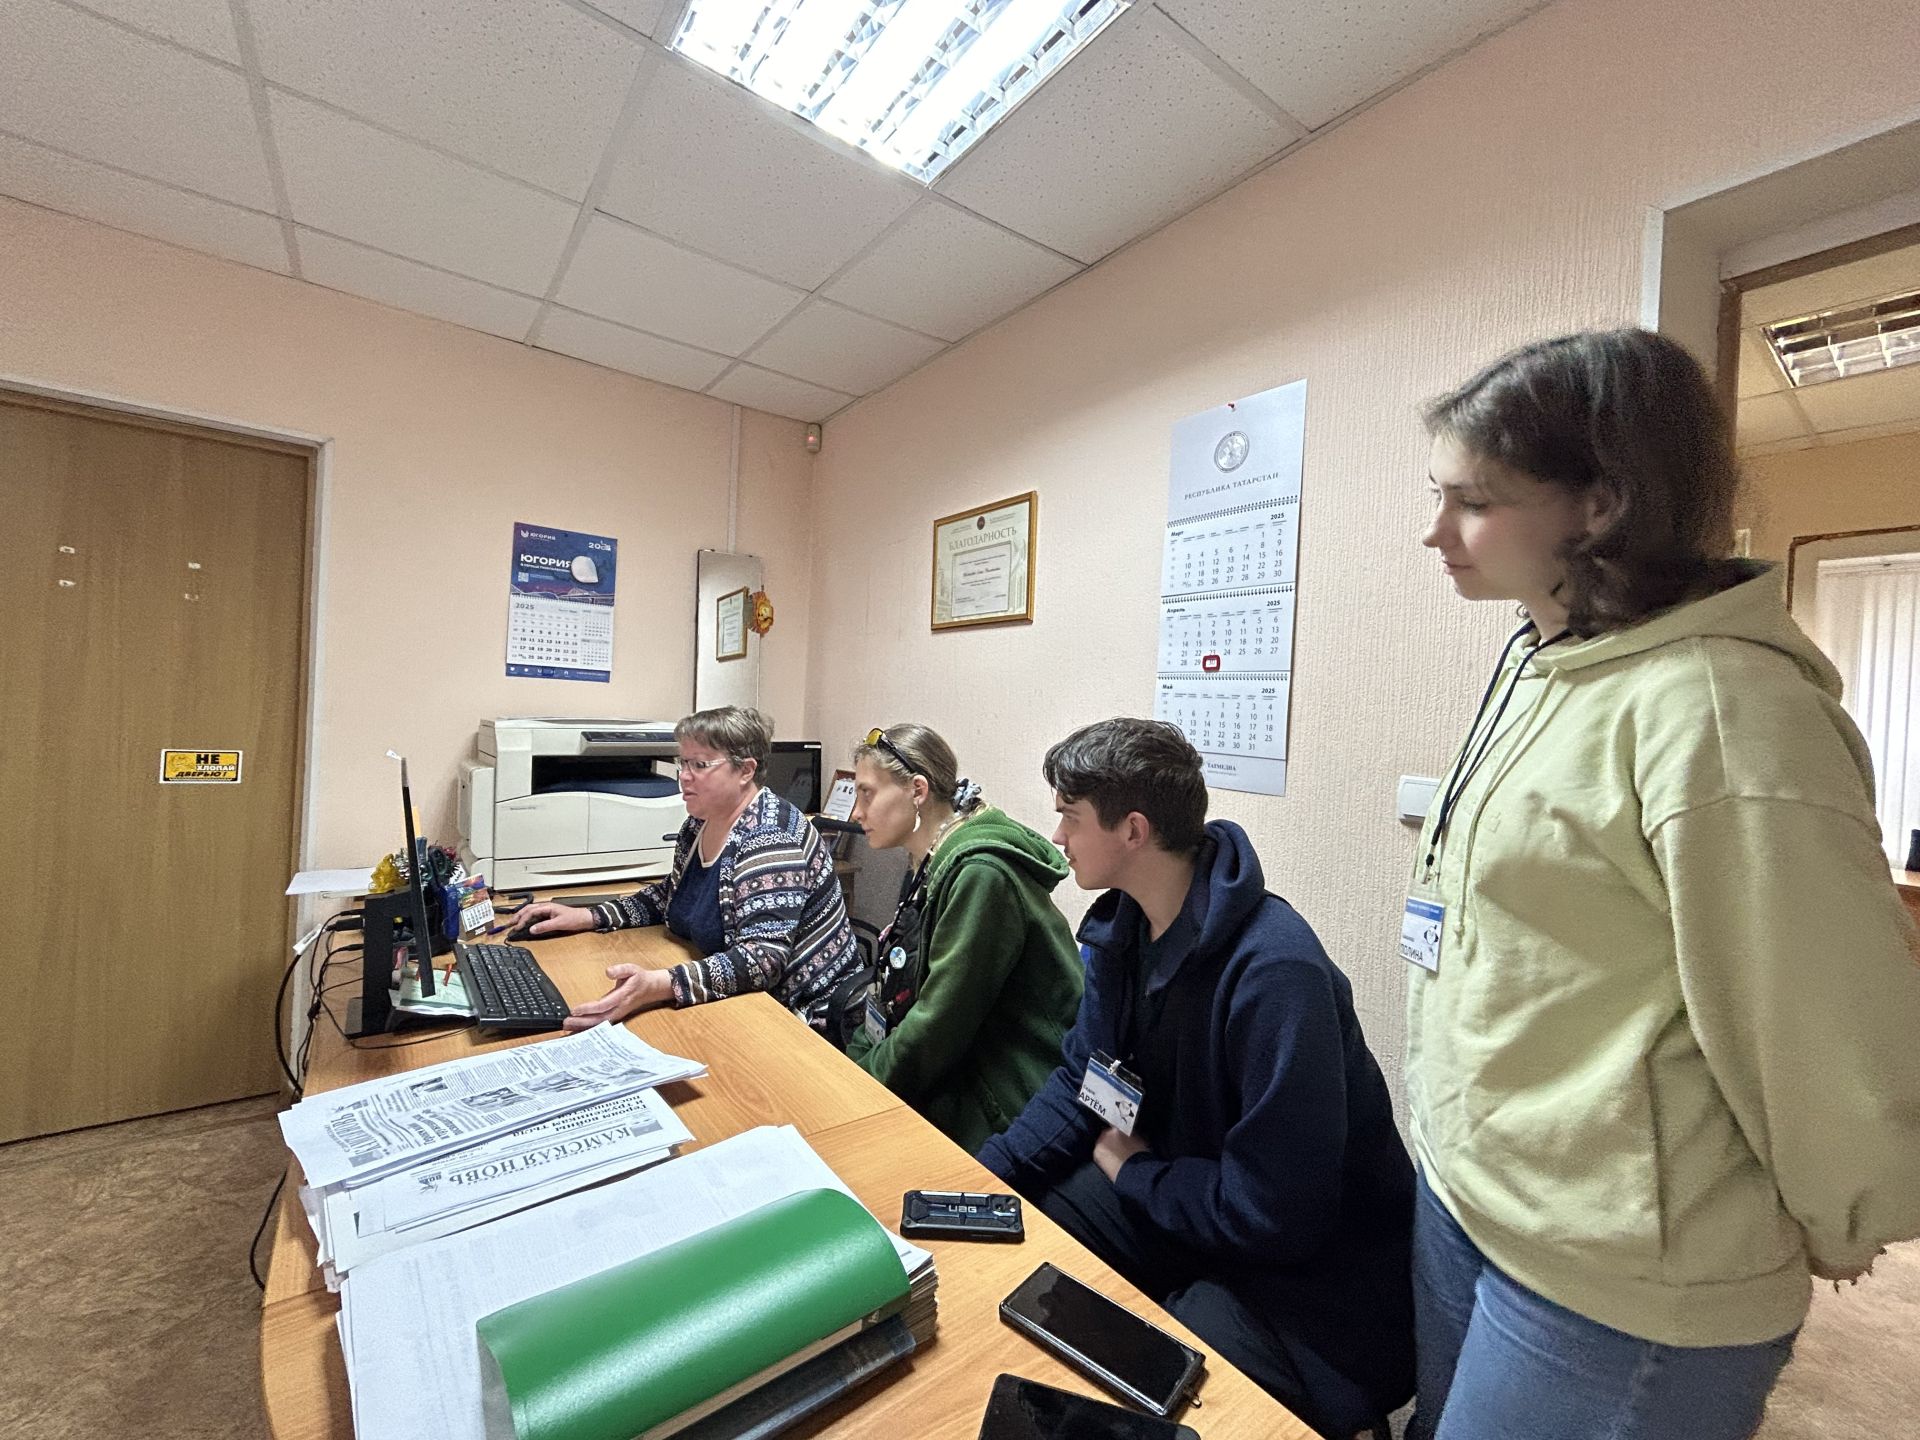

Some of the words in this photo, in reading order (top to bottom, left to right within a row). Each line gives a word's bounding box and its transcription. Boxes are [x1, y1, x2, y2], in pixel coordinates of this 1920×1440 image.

[1184, 484, 1230, 500] РЕСПУБЛИКА
[1232, 472, 1279, 488] ТАТАРСТАН
[520, 554, 571, 568] ЮГОРИЯ
[196, 754, 220, 764] НЕ
[602, 1104, 647, 1118] Героям
[1079, 1092, 1106, 1116] АРТЁМ
[552, 1103, 634, 1127] труженикам
[556, 1116, 599, 1131] войны
[513, 1123, 550, 1137] тыла
[524, 1126, 632, 1165] КАМСКАЯ
[450, 1161, 516, 1186] НОВЬ
